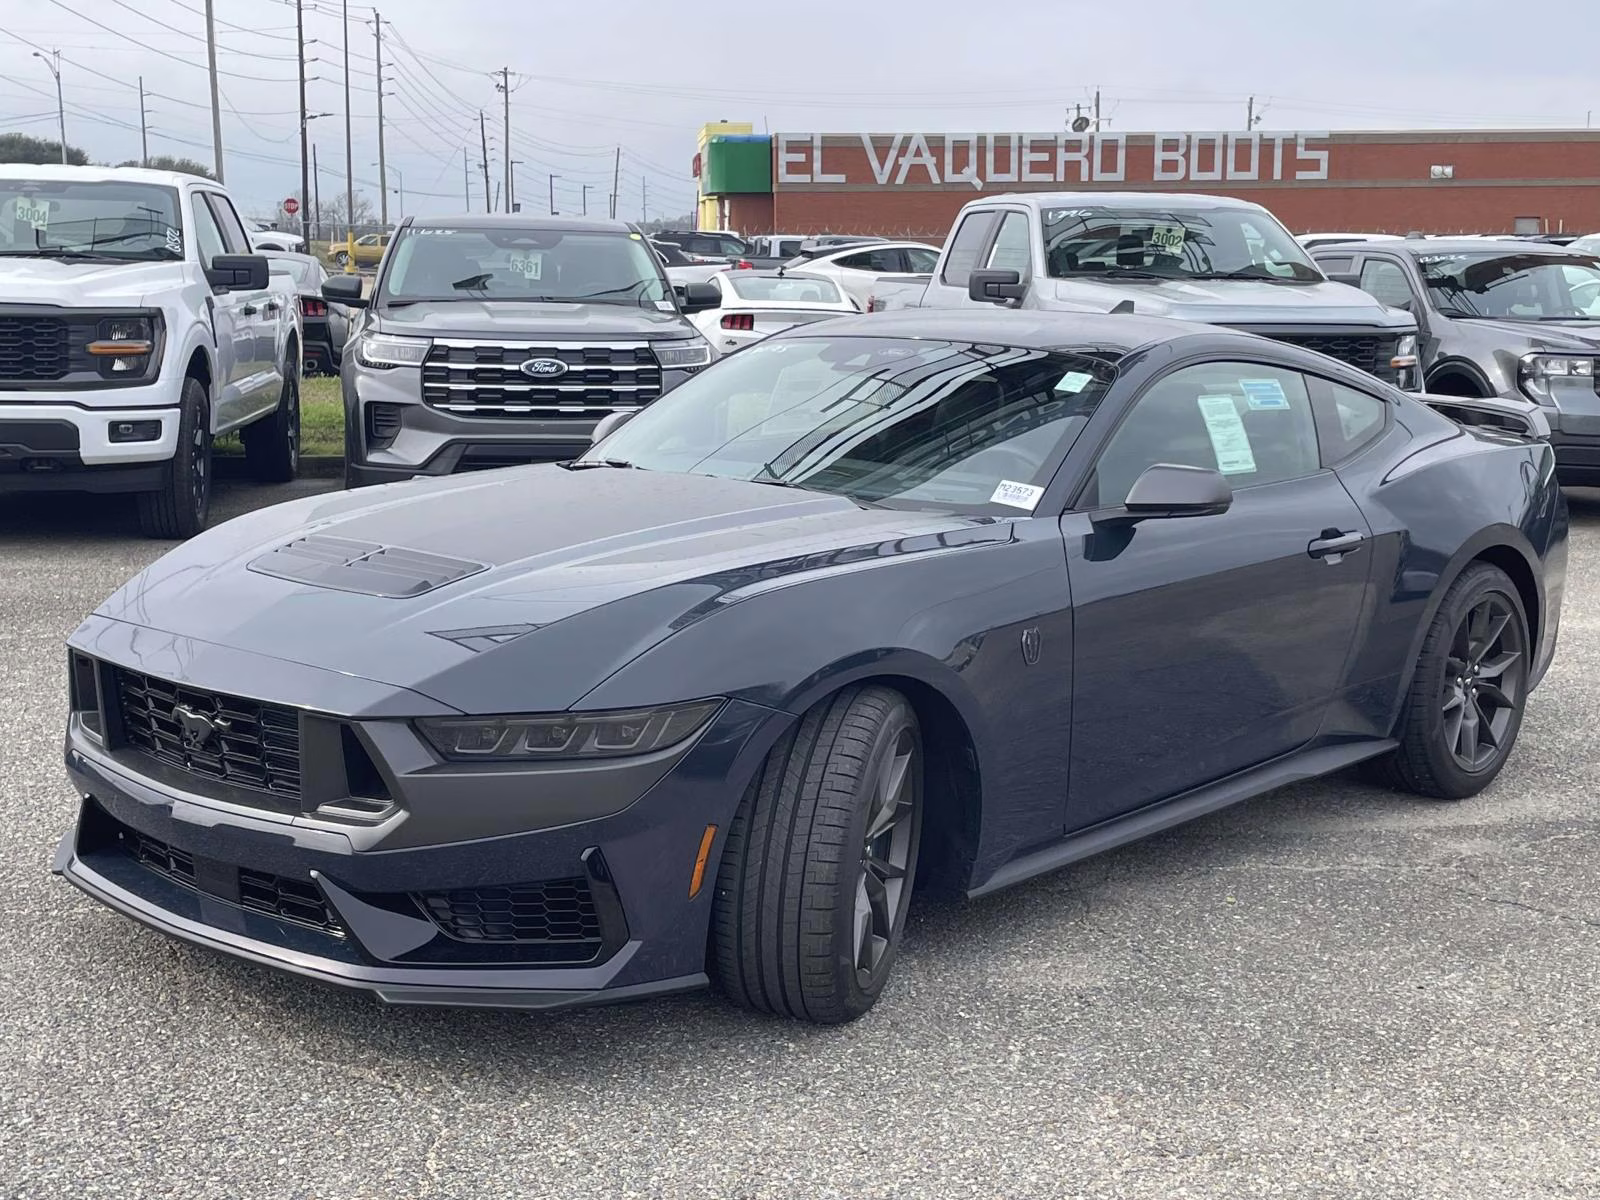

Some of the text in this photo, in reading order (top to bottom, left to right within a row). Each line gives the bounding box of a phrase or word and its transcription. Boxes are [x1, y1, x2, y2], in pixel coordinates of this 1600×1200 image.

[778, 130, 1329, 191] EL VAQUERO BOOTS
[18, 206, 47, 224] 3004
[1152, 231, 1182, 247] 3002
[511, 259, 539, 274] 6361
[531, 361, 558, 373] Ford
